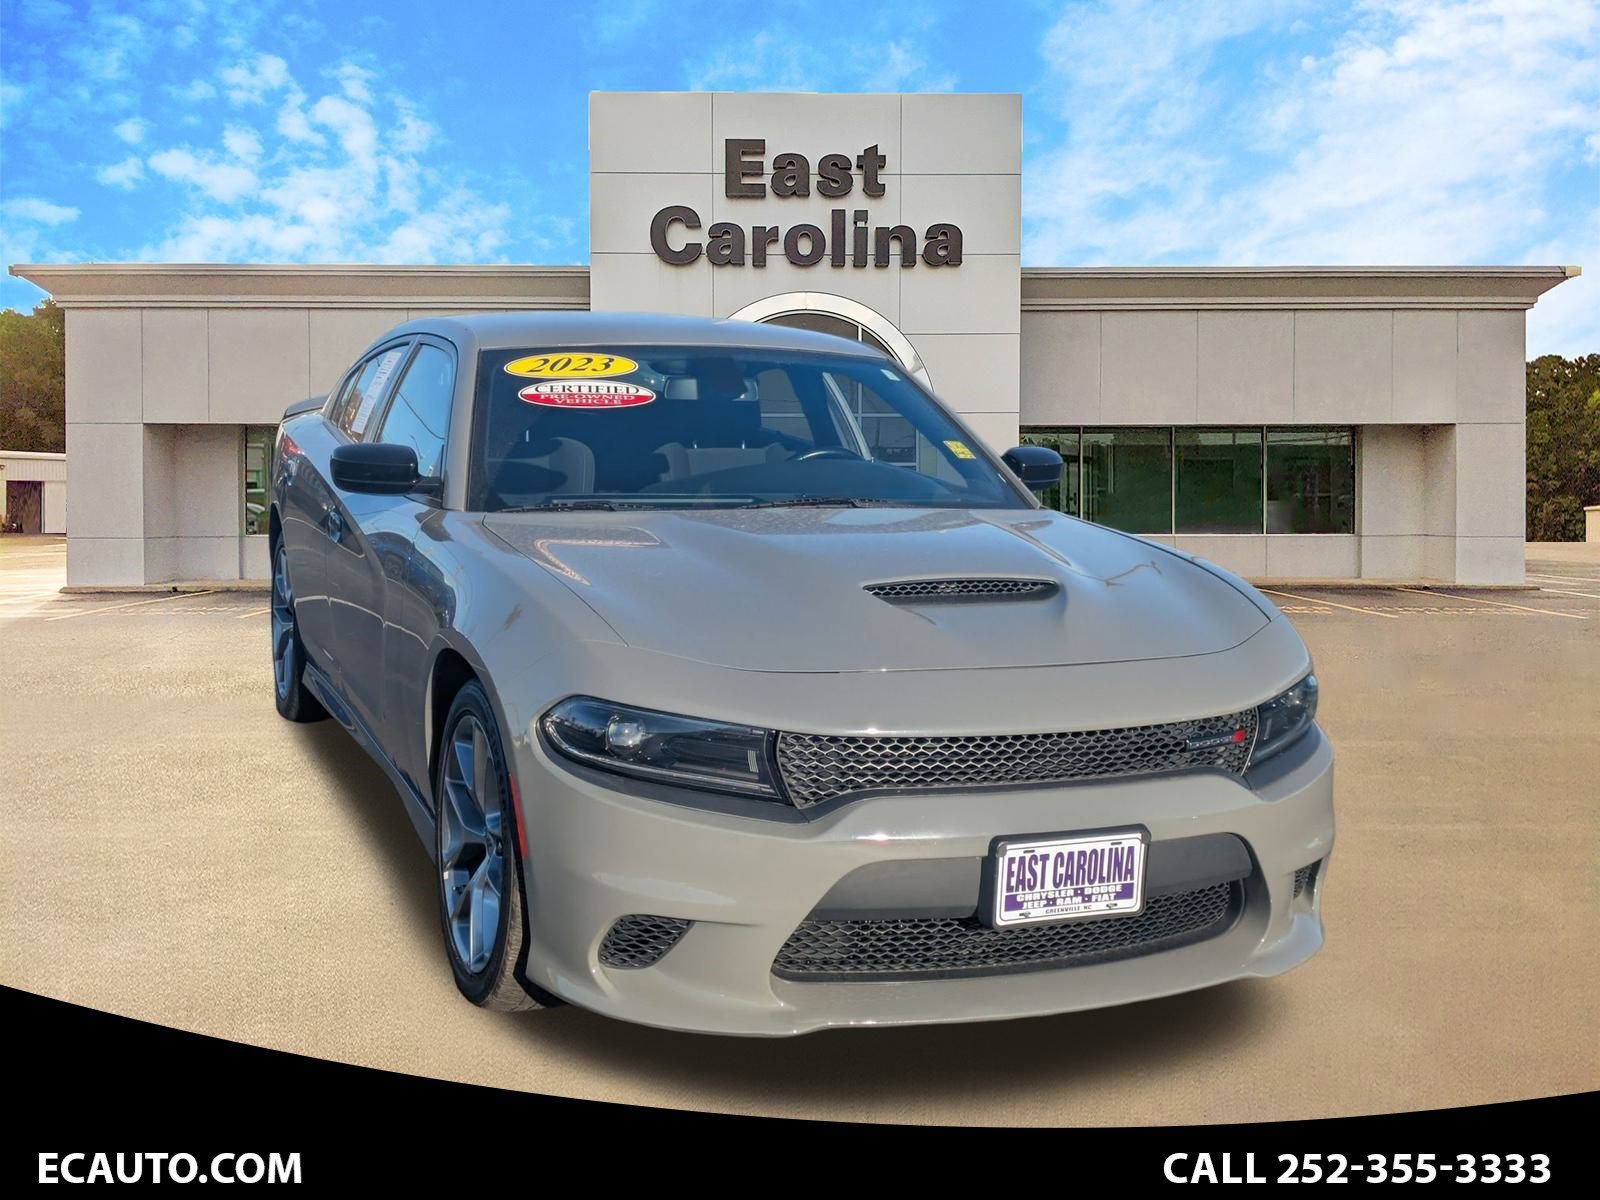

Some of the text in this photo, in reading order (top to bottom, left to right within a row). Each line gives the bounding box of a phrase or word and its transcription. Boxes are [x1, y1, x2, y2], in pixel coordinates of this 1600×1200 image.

[724, 138, 886, 198] East
[649, 205, 963, 268] Carolina
[528, 357, 614, 372] 2023
[535, 384, 639, 395] CERTIFIED
[1007, 846, 1135, 892] EAST CAROLINA
[1016, 884, 1123, 902] CHRYSLER DODGE
[1022, 893, 1117, 909] JEEP RAM FIAT
